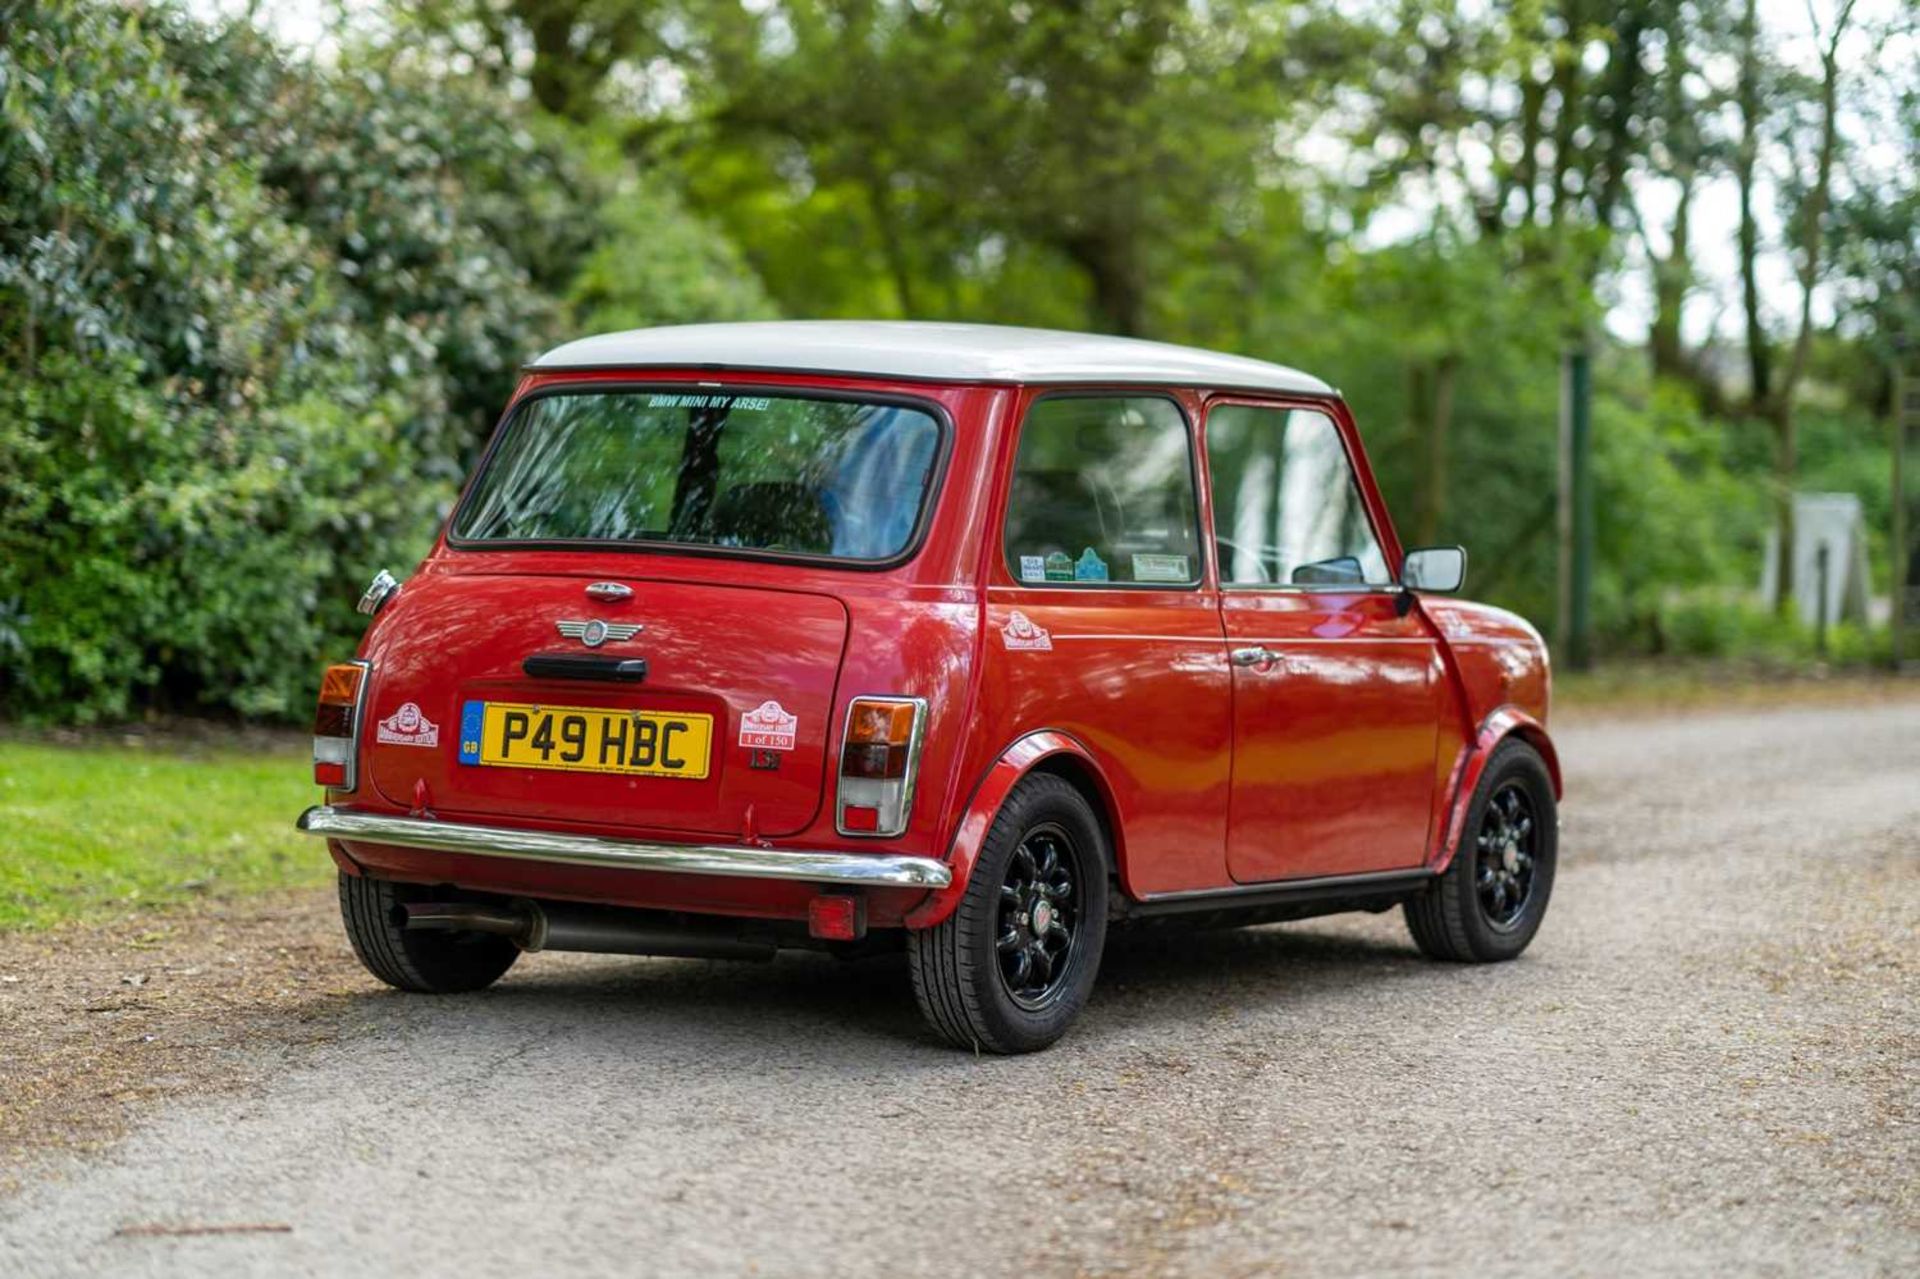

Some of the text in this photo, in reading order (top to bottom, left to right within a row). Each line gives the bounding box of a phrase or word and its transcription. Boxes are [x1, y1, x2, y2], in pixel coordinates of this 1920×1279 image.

[648, 395, 770, 411] BMW MINI MY ARSE!
[463, 741, 478, 754] GB
[501, 712, 588, 763] P49
[598, 717, 689, 769] HBC
[755, 735, 768, 745] of
[770, 735, 788, 746] 150
